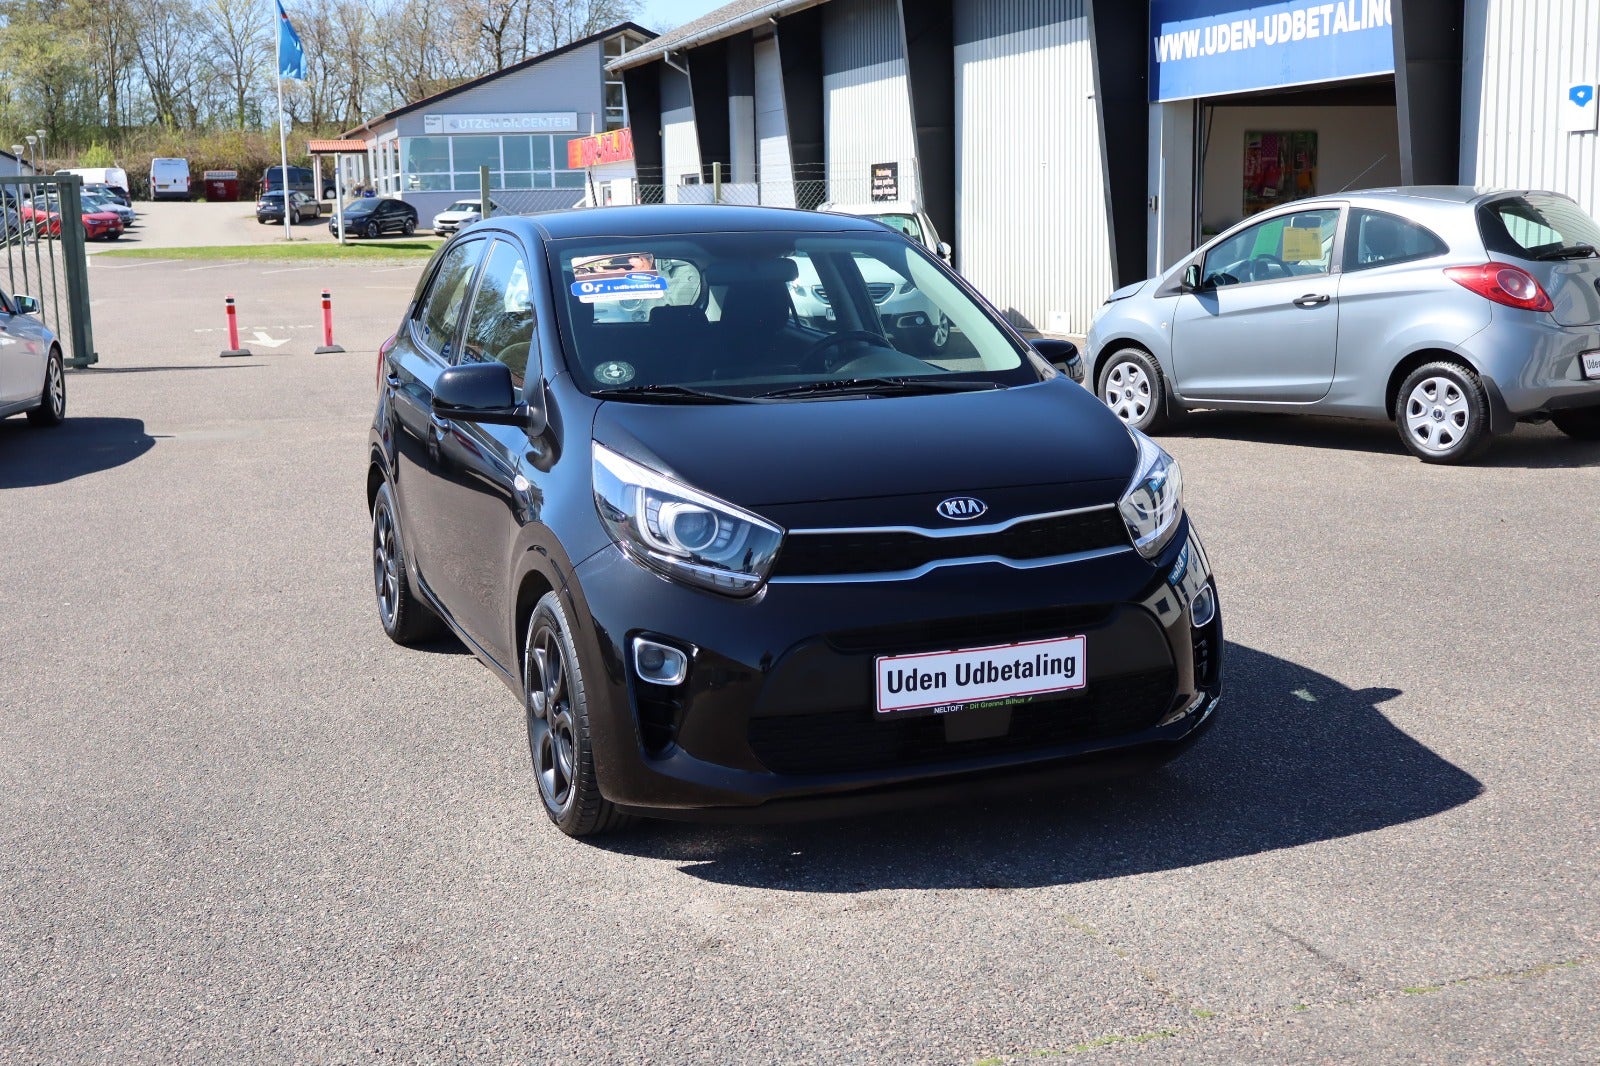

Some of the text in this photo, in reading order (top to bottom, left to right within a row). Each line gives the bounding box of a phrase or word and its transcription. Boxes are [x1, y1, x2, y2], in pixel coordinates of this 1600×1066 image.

[502, 117, 570, 128] BILCENTER
[613, 283, 661, 291] udbetaling
[944, 499, 981, 515] KIA
[887, 653, 1076, 694] Uden Udbetaling
[933, 704, 964, 714] NELTOFT
